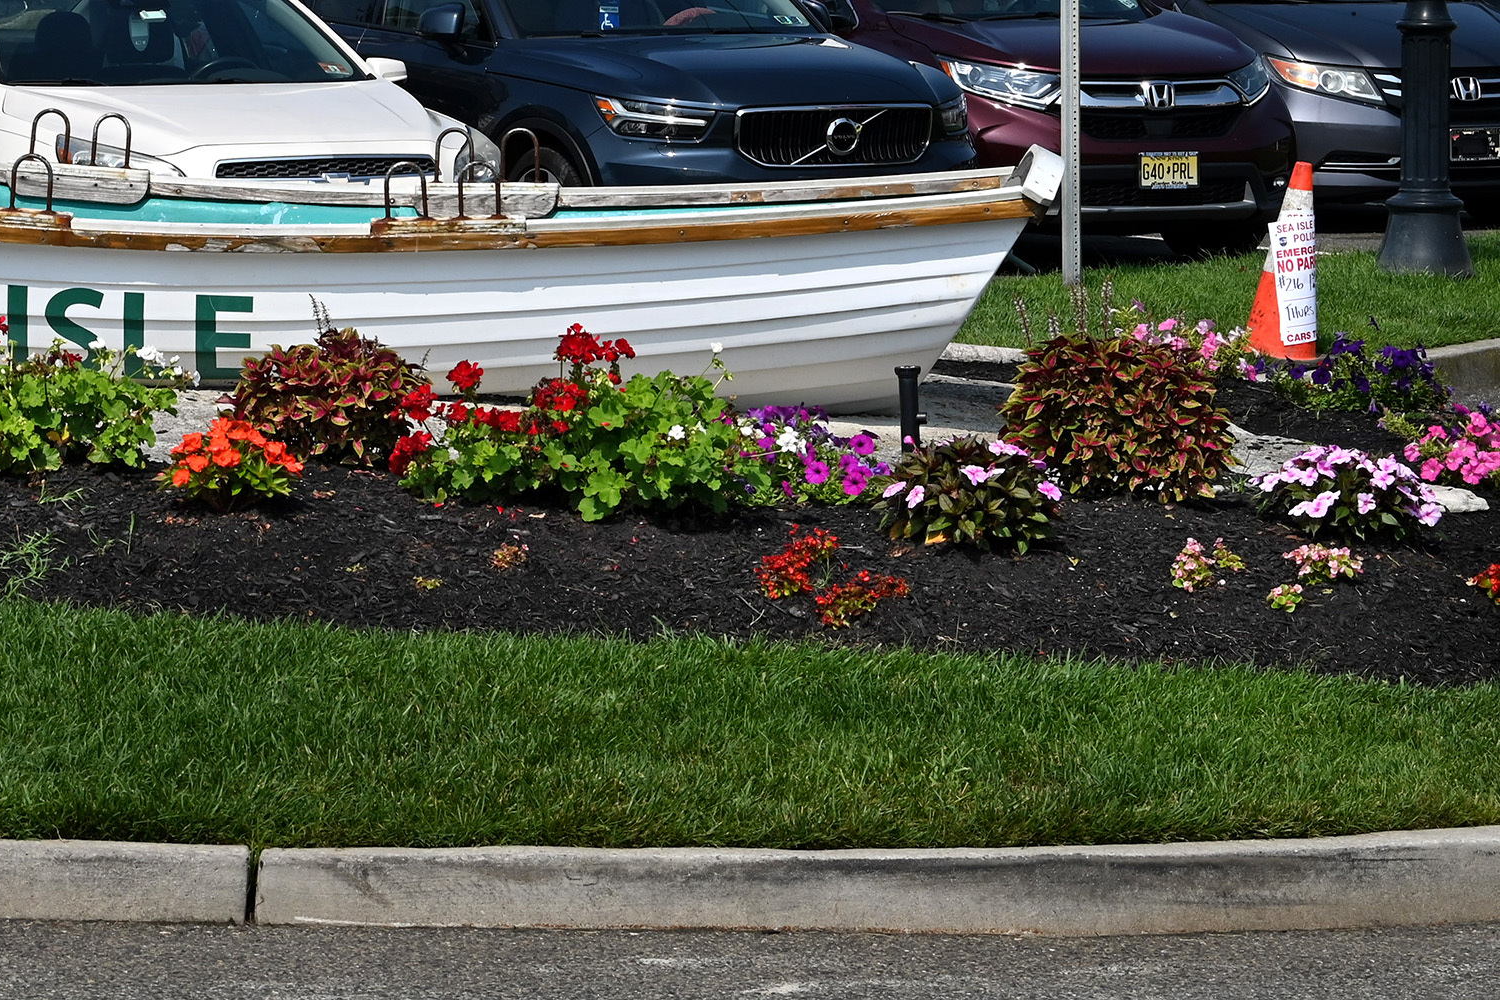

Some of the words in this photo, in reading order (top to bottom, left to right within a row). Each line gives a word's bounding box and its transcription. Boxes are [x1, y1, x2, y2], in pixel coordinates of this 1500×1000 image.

[1142, 162, 1165, 181] G40
[1172, 162, 1194, 180] PRL
[1276, 223, 1294, 234] SEA
[1297, 221, 1314, 231] ISLE
[1277, 258, 1294, 274] NO
[7, 284, 254, 380] ISLE
[1286, 331, 1312, 343] CARS
